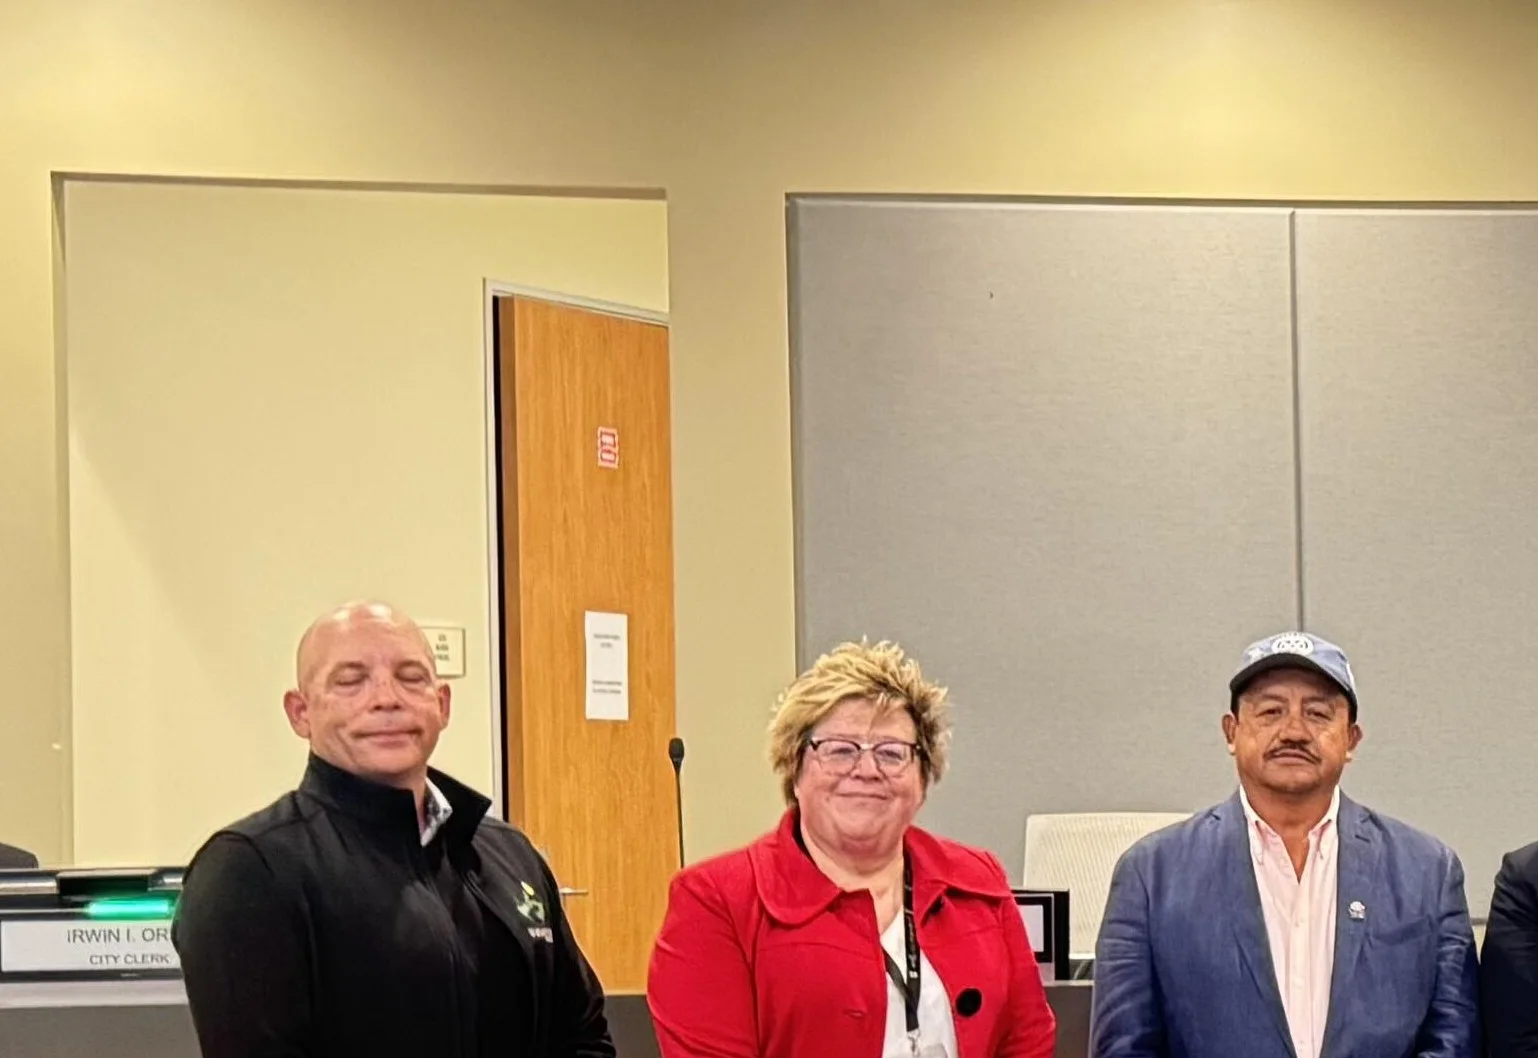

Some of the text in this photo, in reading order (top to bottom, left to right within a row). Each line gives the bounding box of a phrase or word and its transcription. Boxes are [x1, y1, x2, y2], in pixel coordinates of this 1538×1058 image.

[67, 929, 120, 944] IRWIN
[126, 928, 136, 943] I.
[89, 953, 170, 965] CITY CLERK
